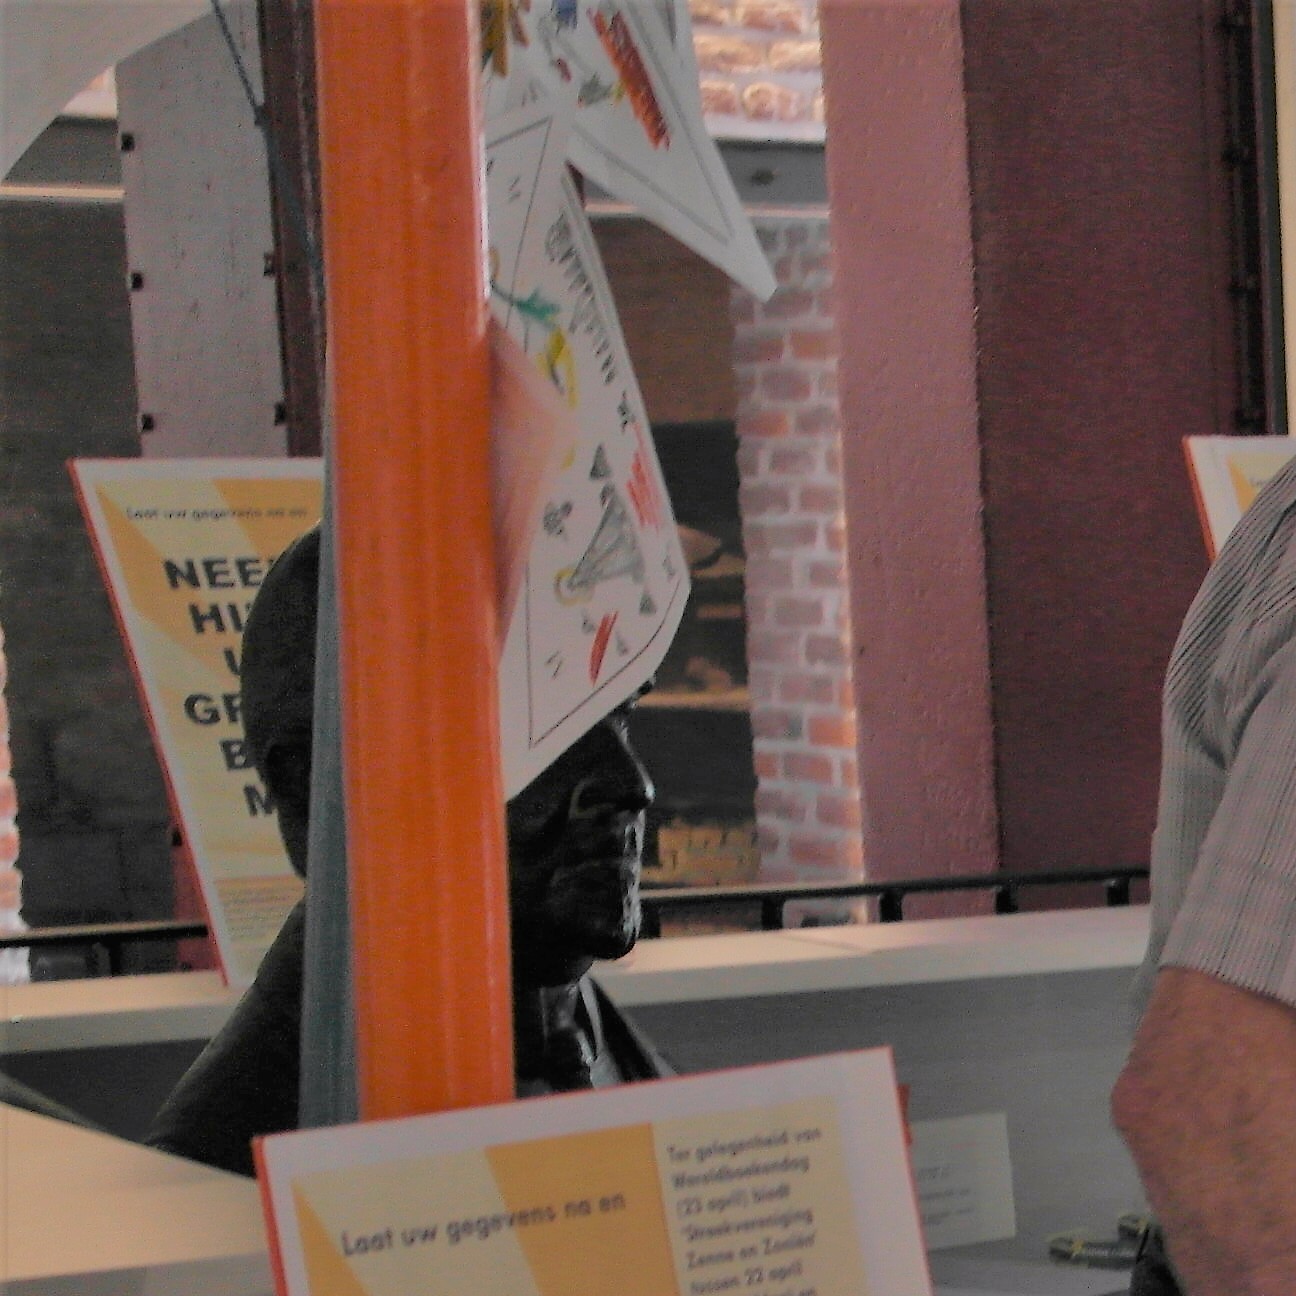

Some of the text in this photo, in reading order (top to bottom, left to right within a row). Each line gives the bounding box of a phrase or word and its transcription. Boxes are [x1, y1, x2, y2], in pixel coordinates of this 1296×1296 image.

[164, 557, 274, 590] NEE
[188, 603, 251, 634] HI
[695, 1130, 788, 1163] gelegenheid
[793, 1127, 821, 1142] van
[672, 1156, 809, 1188] Wereldboekendag
[341, 1193, 626, 1258] Laat uw gegevens na en
[686, 1250, 734, 1270] Zenne
[738, 1245, 757, 1260] en
[690, 1260, 803, 1295] tussen 22 april
